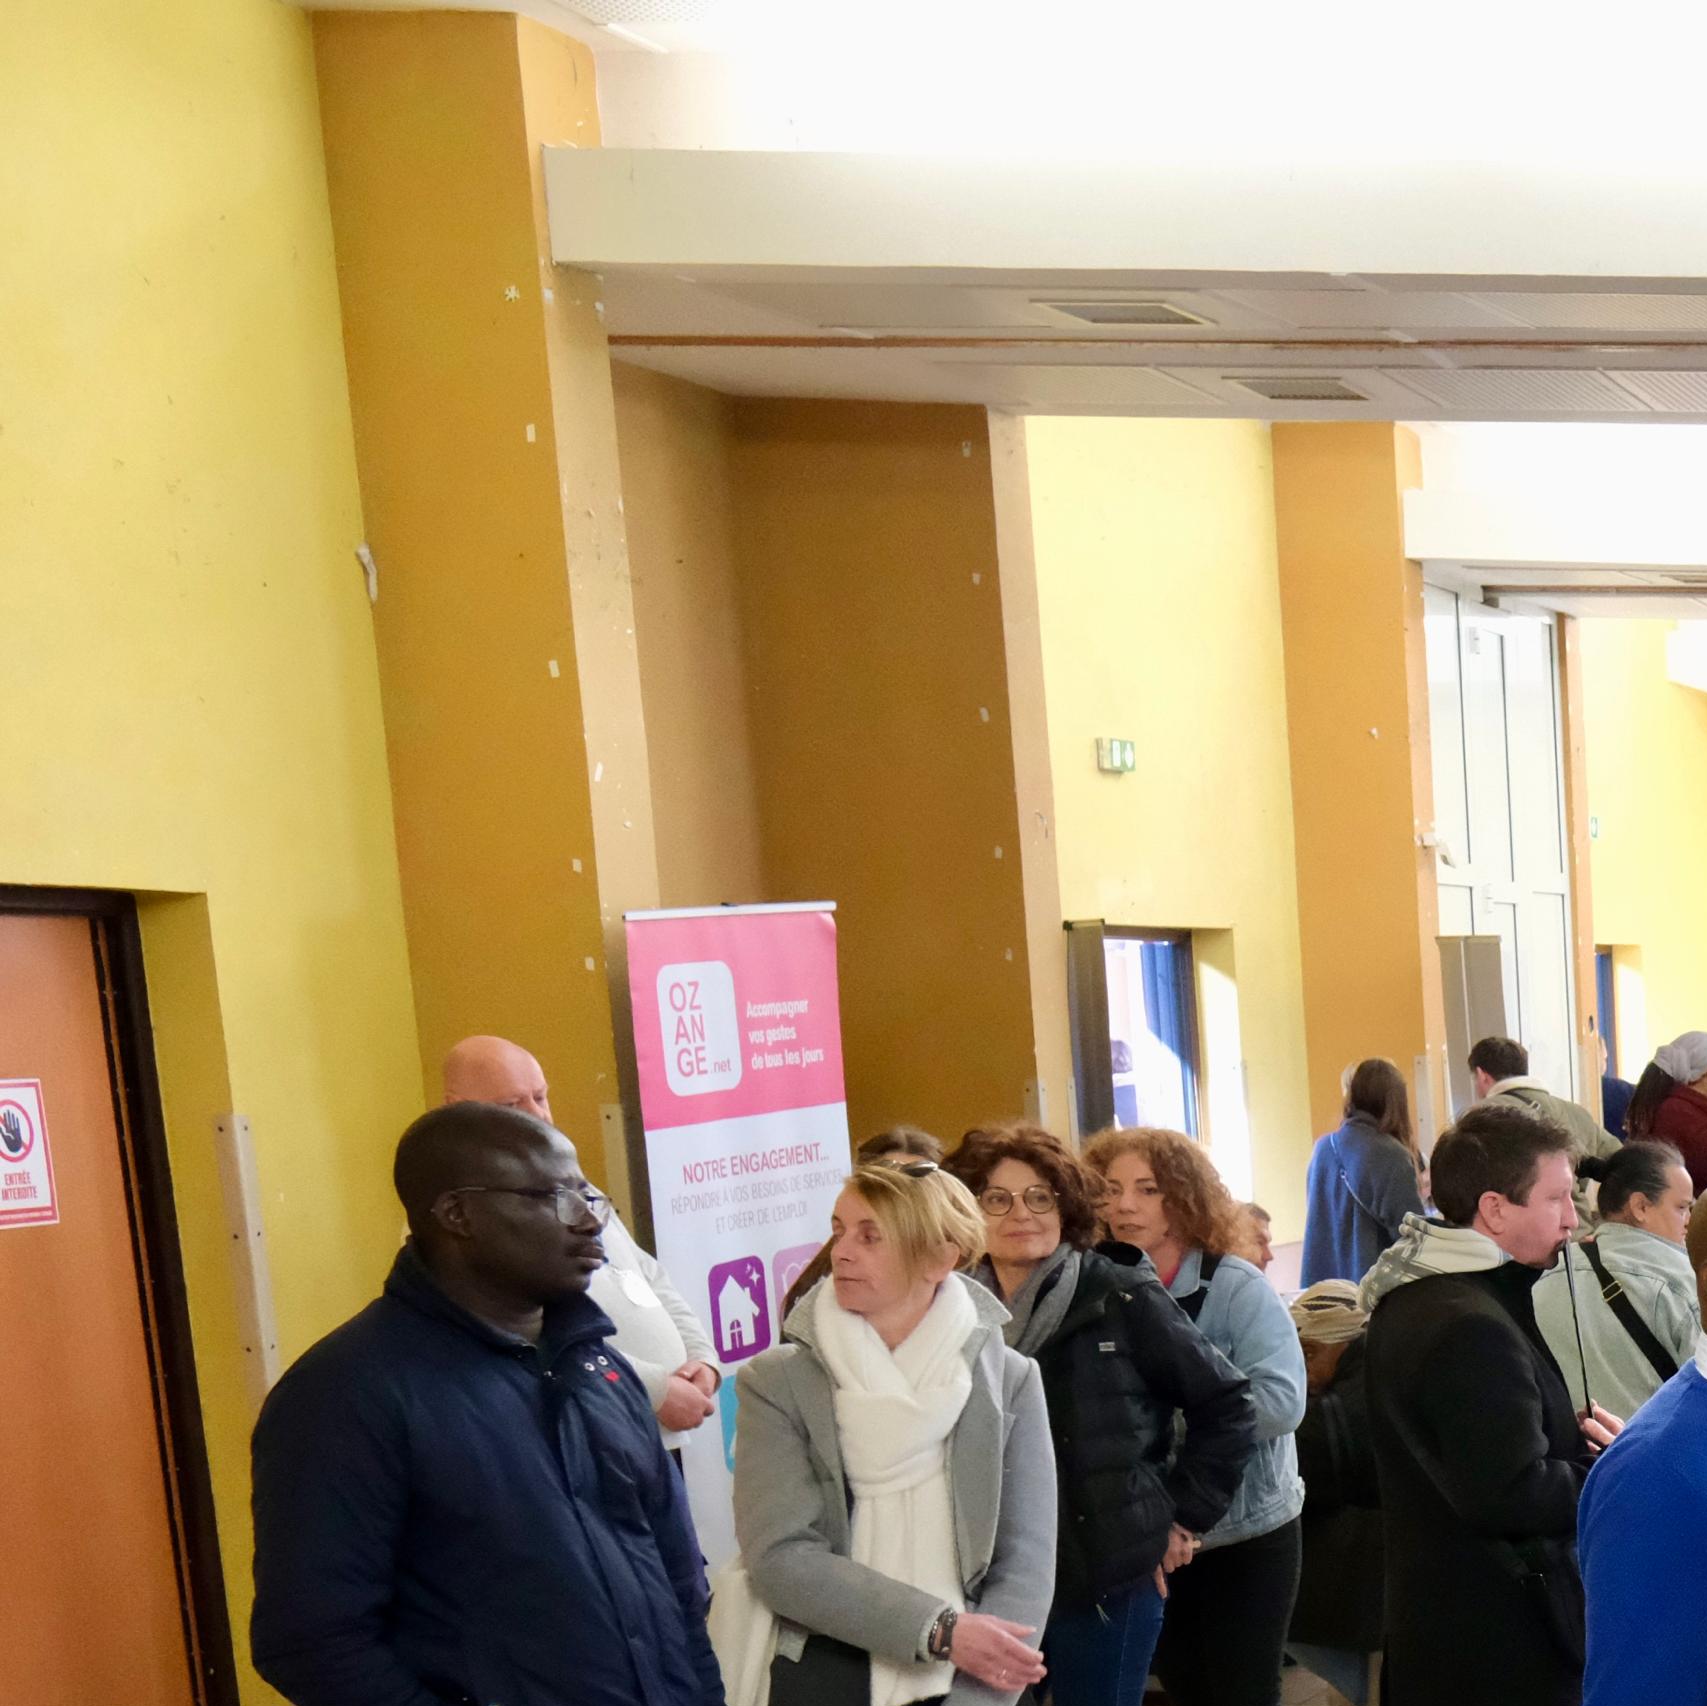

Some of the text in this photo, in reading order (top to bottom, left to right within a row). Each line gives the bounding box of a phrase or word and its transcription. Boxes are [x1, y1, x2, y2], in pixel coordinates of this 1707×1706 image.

[669, 981, 702, 1013] OZ
[746, 998, 809, 1020] Accompagner
[674, 1014, 705, 1046] AN
[749, 1026, 796, 1044] vos gestes
[677, 1046, 708, 1078] GE
[751, 1048, 824, 1070] de tous les jours
[4, 1169, 32, 1186] ENTRÉE
[683, 1159, 728, 1185] NOTRE
